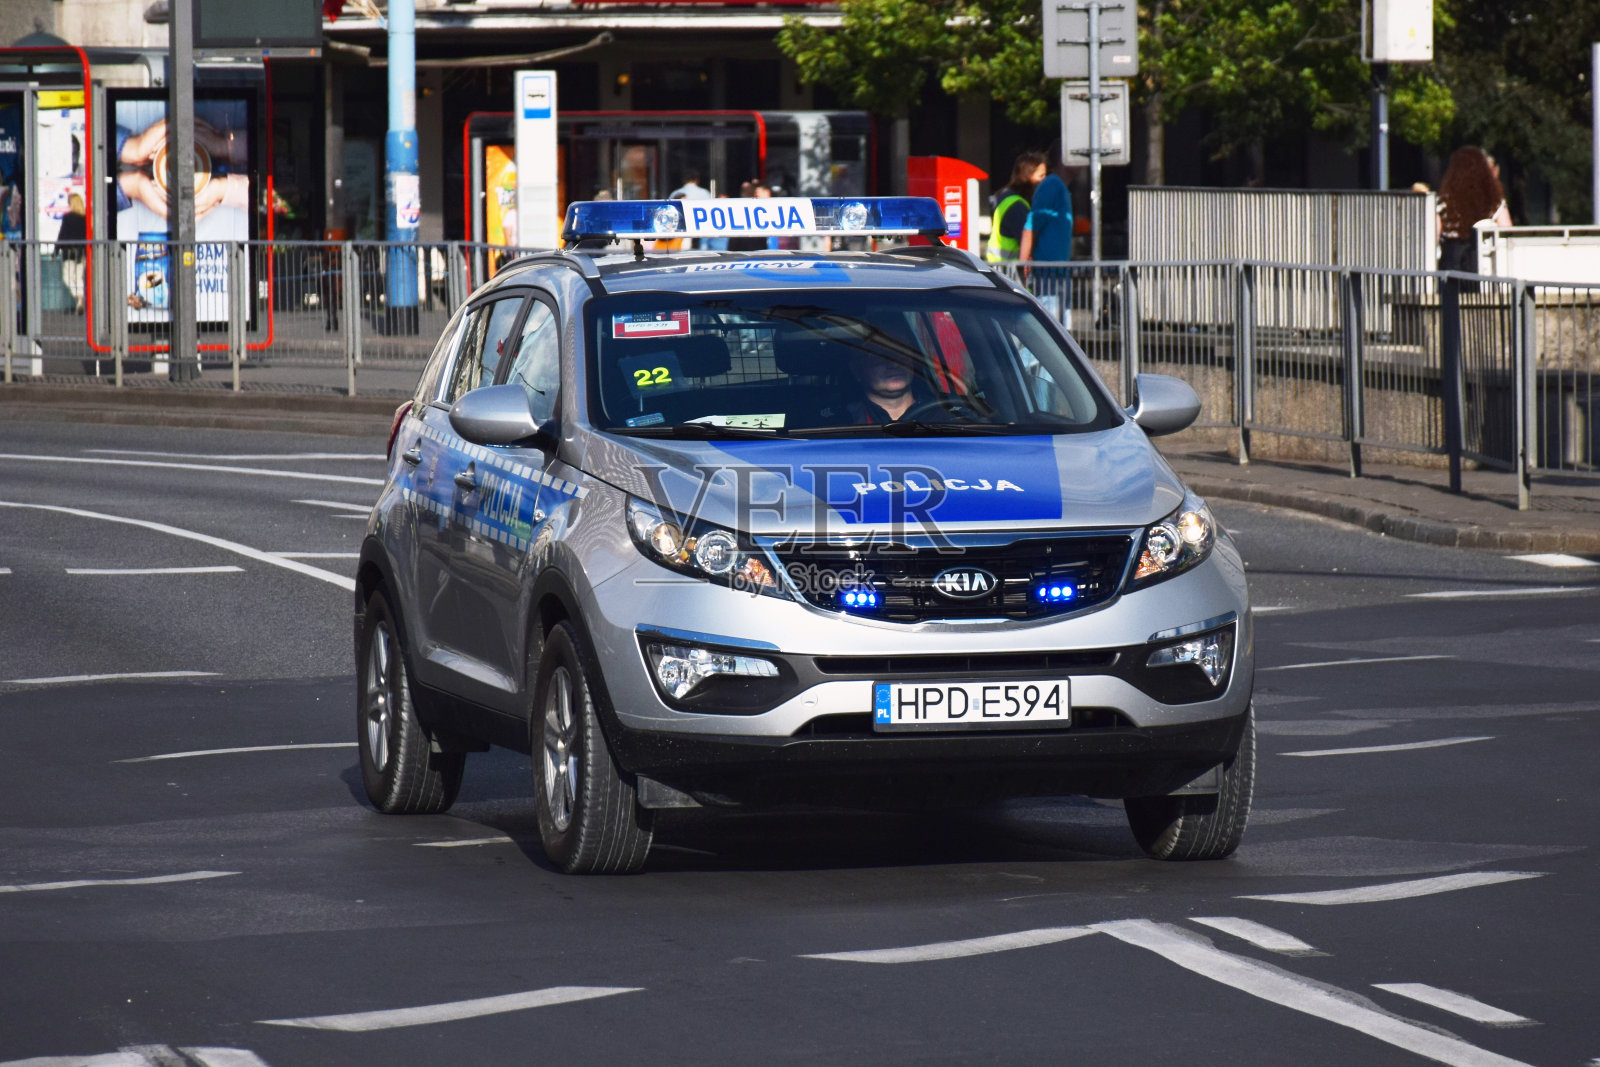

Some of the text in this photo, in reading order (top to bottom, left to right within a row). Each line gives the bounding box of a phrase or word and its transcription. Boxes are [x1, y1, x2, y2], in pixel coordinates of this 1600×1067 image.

[692, 205, 806, 231] POLICJA
[633, 366, 672, 387] 22
[852, 478, 1025, 495] POLICJA
[477, 470, 523, 529] POLICJA
[944, 572, 989, 592] KIA
[877, 684, 1060, 720] PL HPD E594
